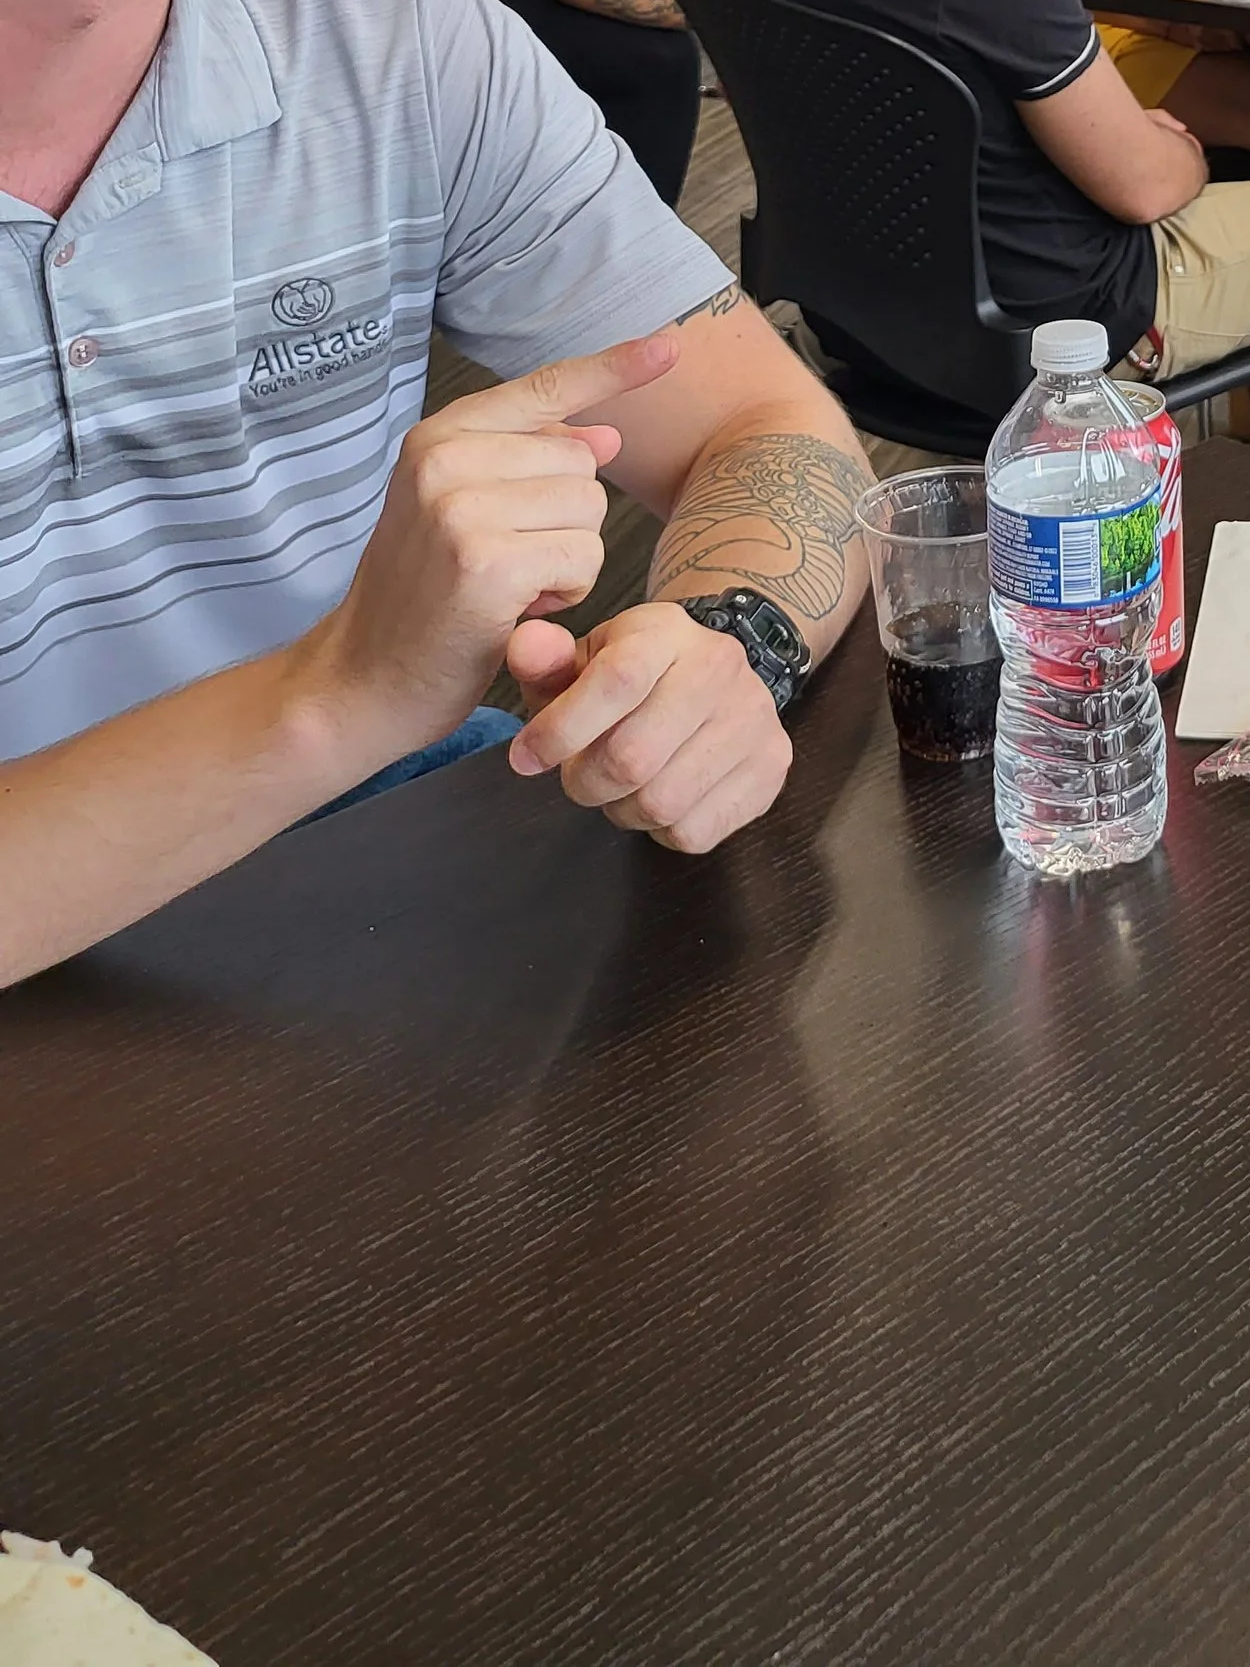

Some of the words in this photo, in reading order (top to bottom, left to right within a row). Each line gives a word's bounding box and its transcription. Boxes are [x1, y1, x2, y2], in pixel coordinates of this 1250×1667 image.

[248, 319, 381, 382] Allstate
[249, 374, 296, 397] You're
[299, 368, 313, 382] in
[316, 354, 349, 381] good
